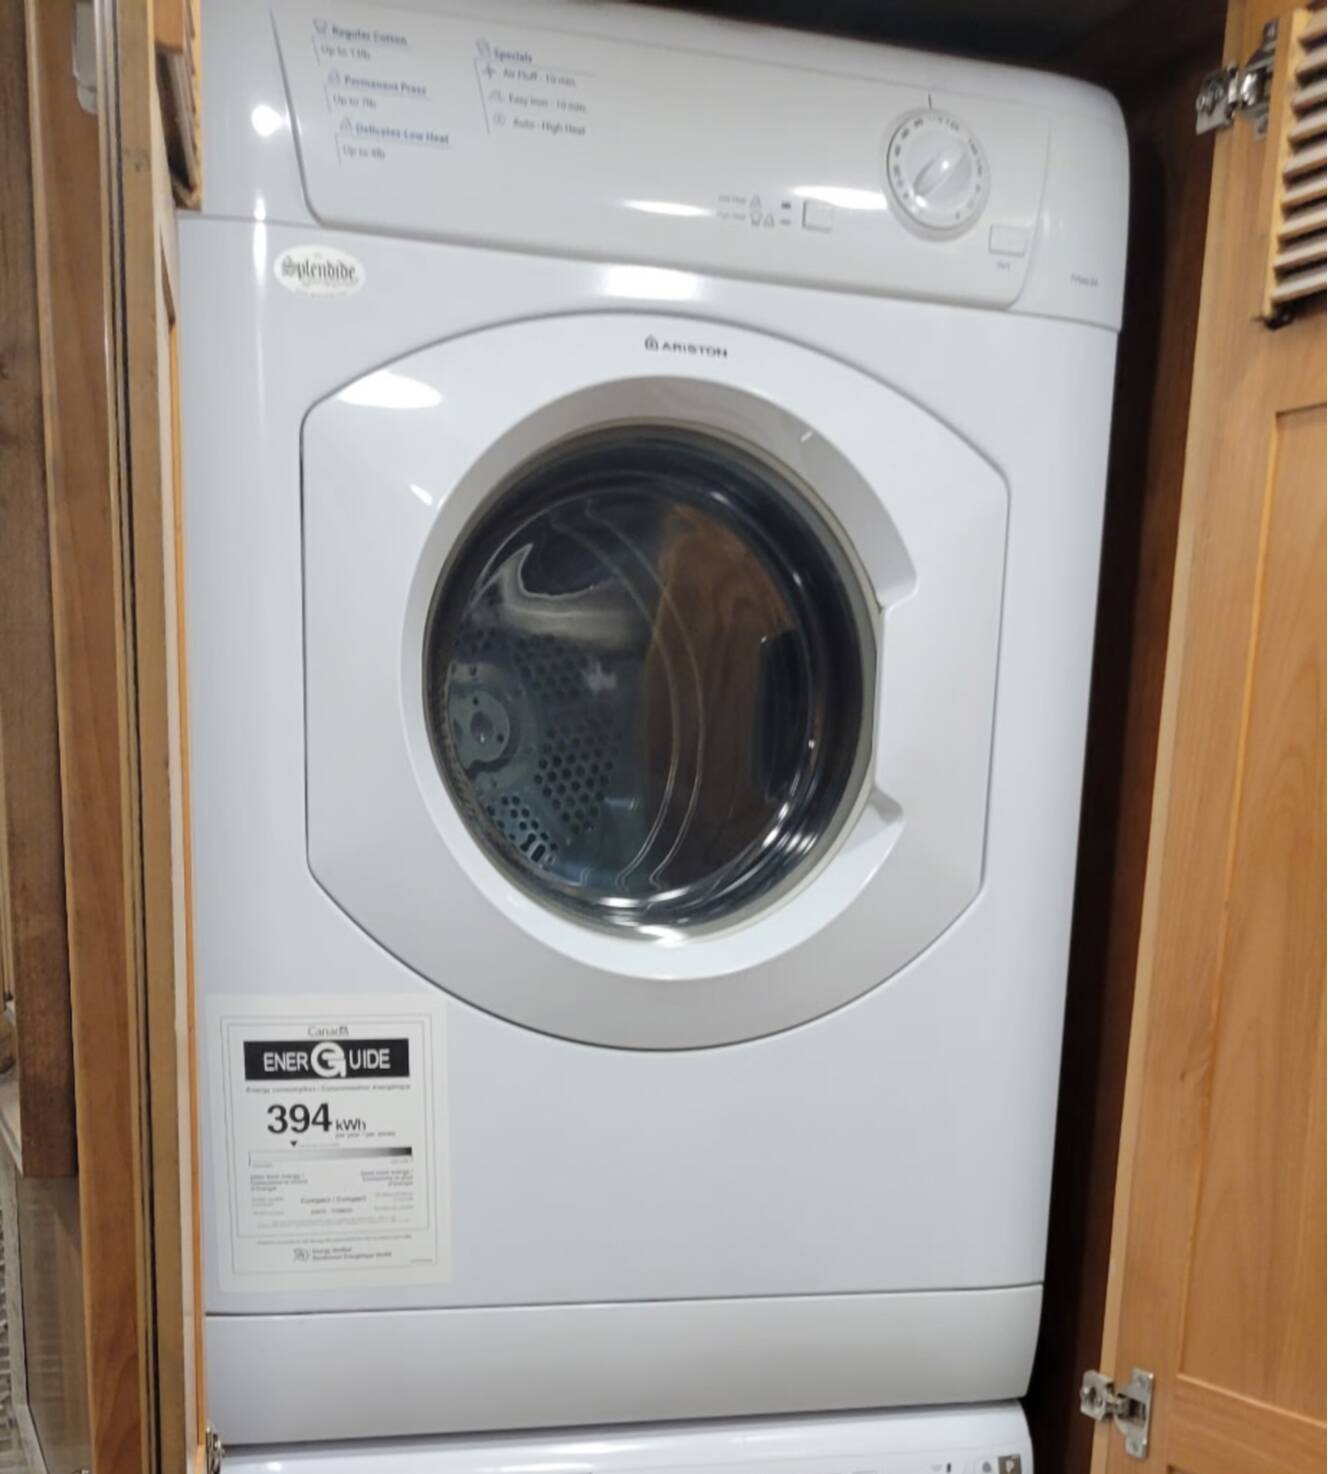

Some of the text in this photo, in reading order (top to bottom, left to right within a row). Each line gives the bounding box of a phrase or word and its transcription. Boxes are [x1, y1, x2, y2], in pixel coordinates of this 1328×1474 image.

[280, 254, 357, 282] Splendide
[661, 340, 728, 359] ARISTON
[266, 1102, 367, 1135] 394 kWh
